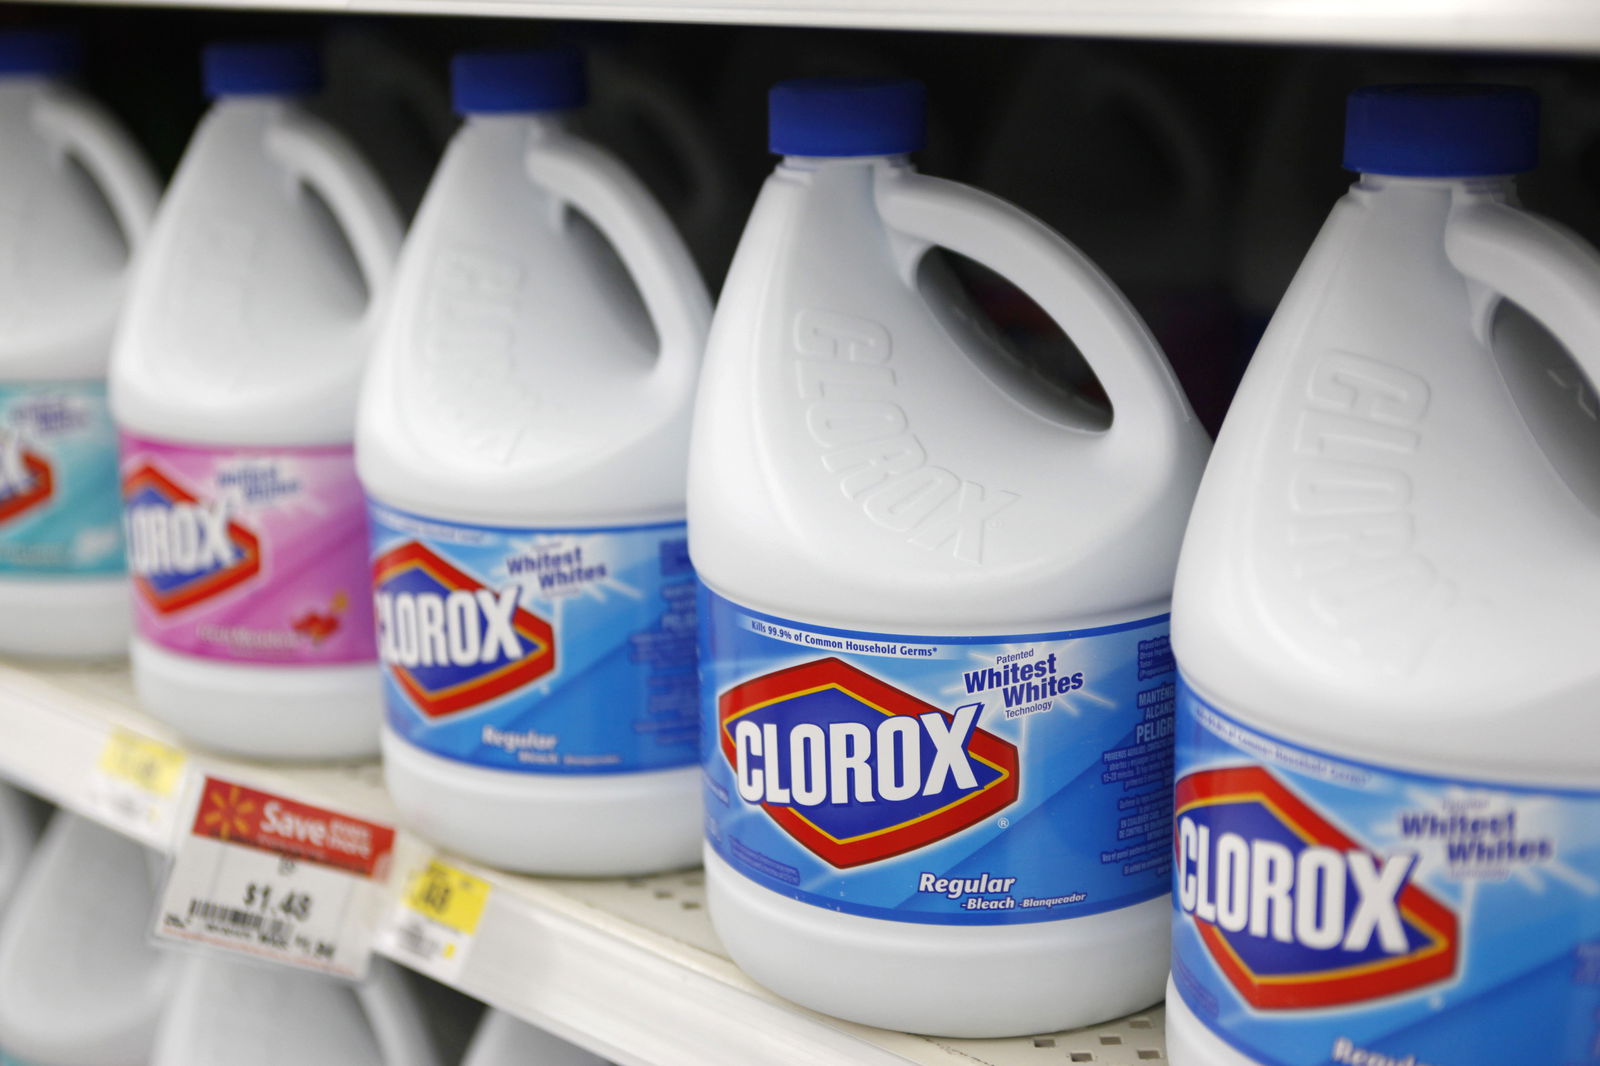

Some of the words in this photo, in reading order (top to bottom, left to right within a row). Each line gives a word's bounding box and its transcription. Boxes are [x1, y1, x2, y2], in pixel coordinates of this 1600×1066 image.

[793, 308, 1023, 565] CLOROX
[751, 620, 766, 633] Kills
[768, 626, 792, 640] 99.9%
[794, 632, 803, 643] of
[805, 636, 843, 649] Common
[845, 641, 897, 655] Household
[964, 653, 1057, 694] Whitest
[996, 648, 1034, 664] Patented
[1002, 672, 1084, 708] Whites
[1005, 701, 1053, 718] Technology
[735, 702, 983, 806] CLOROX
[259, 800, 327, 846] Save
[919, 873, 1016, 899] Regular
[961, 898, 1015, 910] -Bleach
[1019, 893, 1086, 908] -Blanqueador
[1179, 816, 1418, 954] CLOROX
